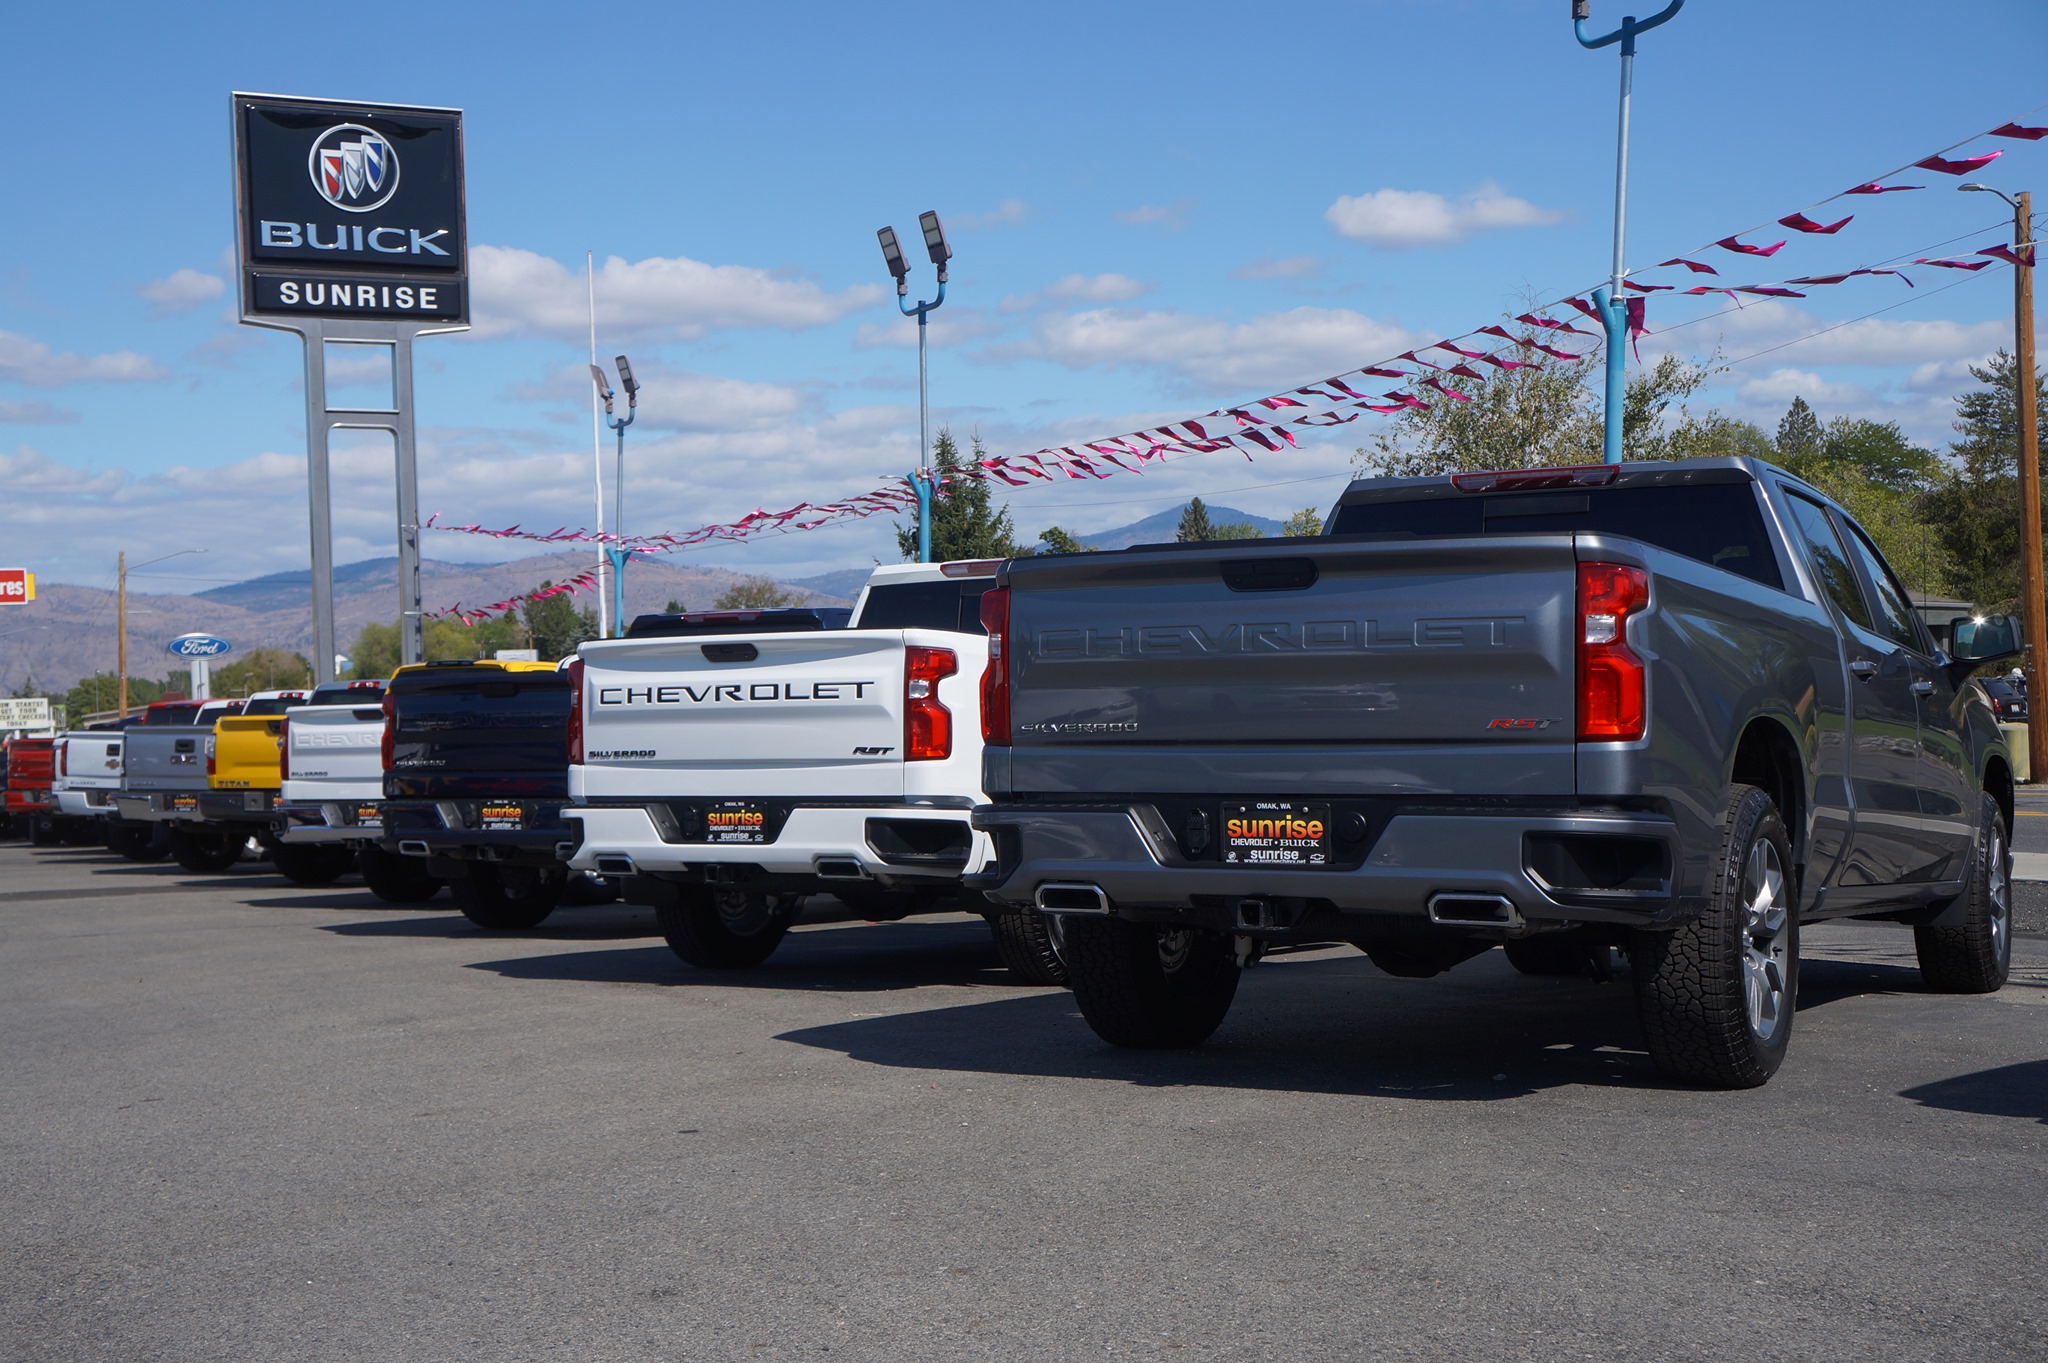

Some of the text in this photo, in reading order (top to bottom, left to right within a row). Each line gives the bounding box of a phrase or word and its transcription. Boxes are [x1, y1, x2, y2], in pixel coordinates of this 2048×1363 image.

[260, 220, 451, 256] BUICK
[279, 282, 438, 309] SUNRISE
[1038, 616, 1526, 657] CHEVROLET
[181, 639, 219, 654] Ford
[599, 681, 875, 705] CHEVROLET
[1021, 723, 1138, 733] SILVERADO
[1486, 717, 1562, 729] RST
[588, 750, 656, 758] SILVERADO
[852, 746, 895, 756] RST
[482, 805, 522, 817] sunrise
[707, 809, 763, 825] sunrise
[1227, 814, 1324, 838] sunrise
[720, 831, 749, 839] sunrise
[1230, 838, 1320, 847] CHEVROLET BUICK
[1250, 848, 1299, 860] sunrise
